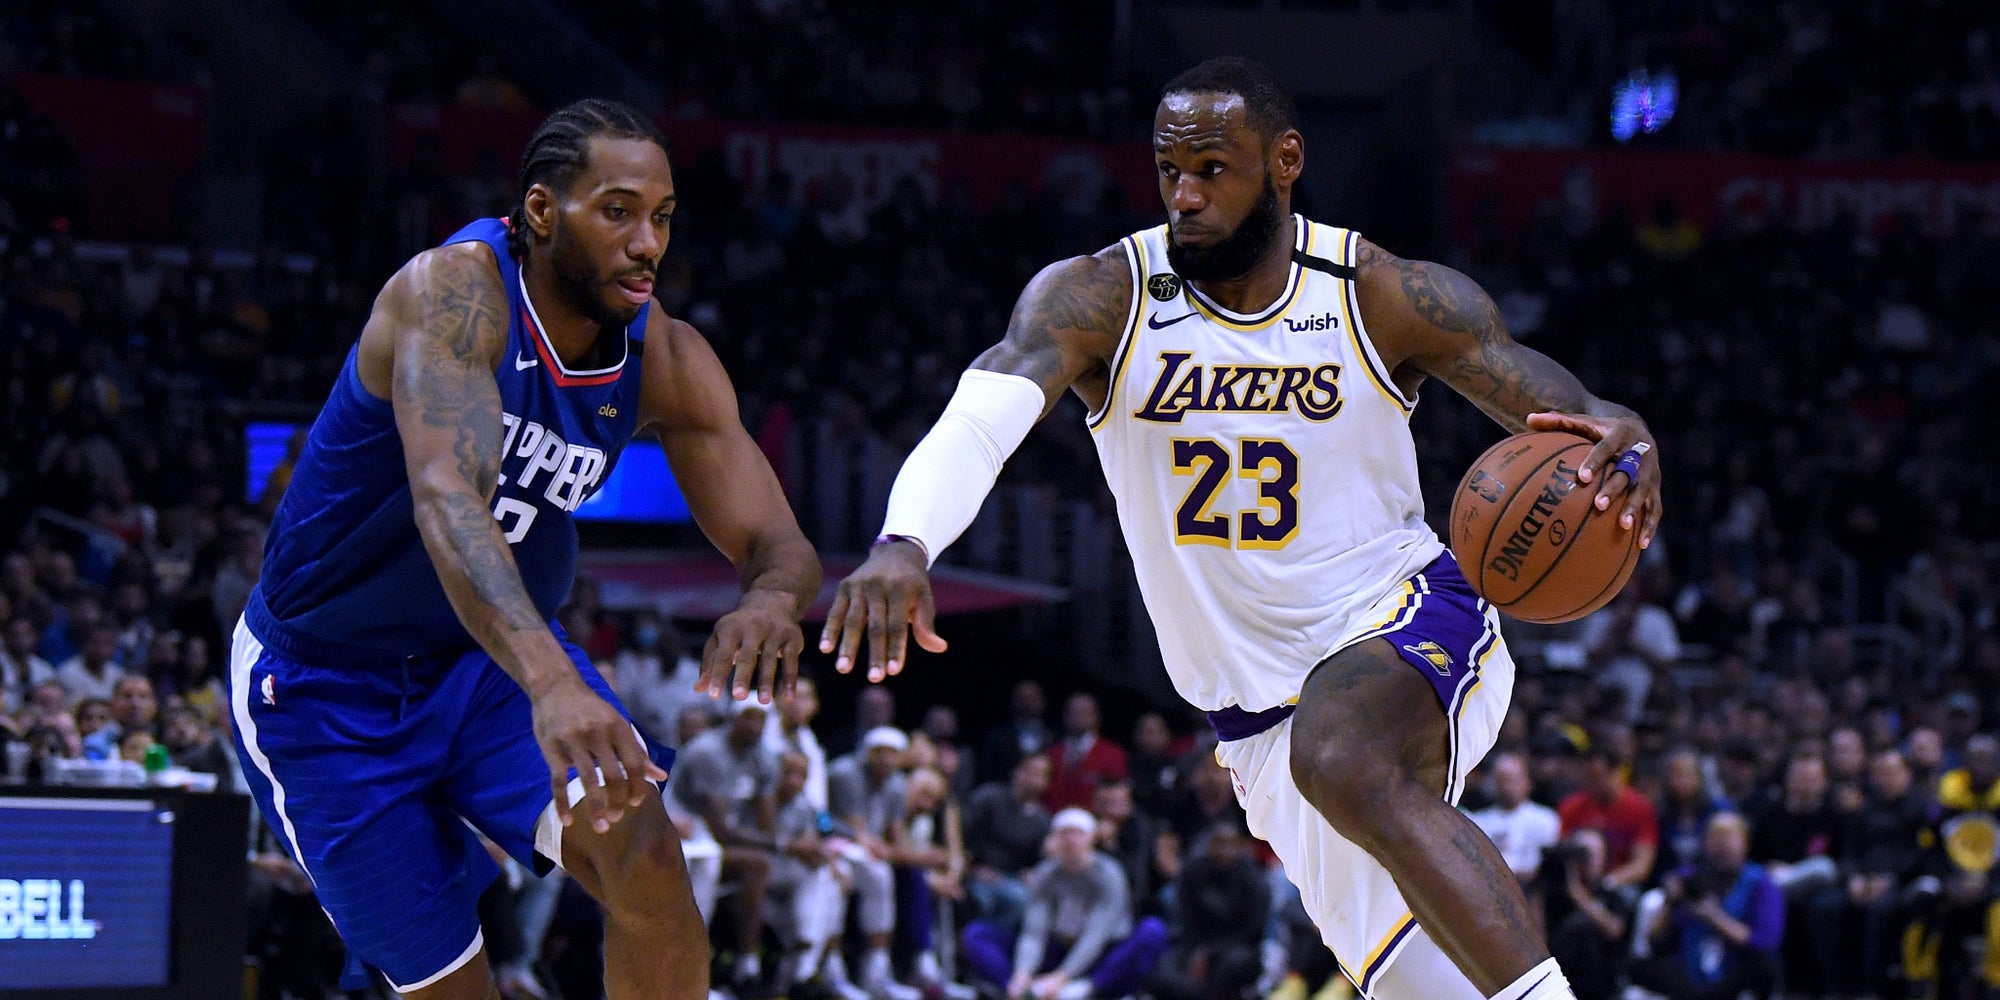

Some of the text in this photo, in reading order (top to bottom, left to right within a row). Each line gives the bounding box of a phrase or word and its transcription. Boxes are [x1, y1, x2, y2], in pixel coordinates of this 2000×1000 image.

[1283, 312, 1339, 333] wish
[1132, 350, 1345, 425] LAKERS
[1169, 437, 1301, 550] 23
[1490, 459, 1579, 583] SPALDING
